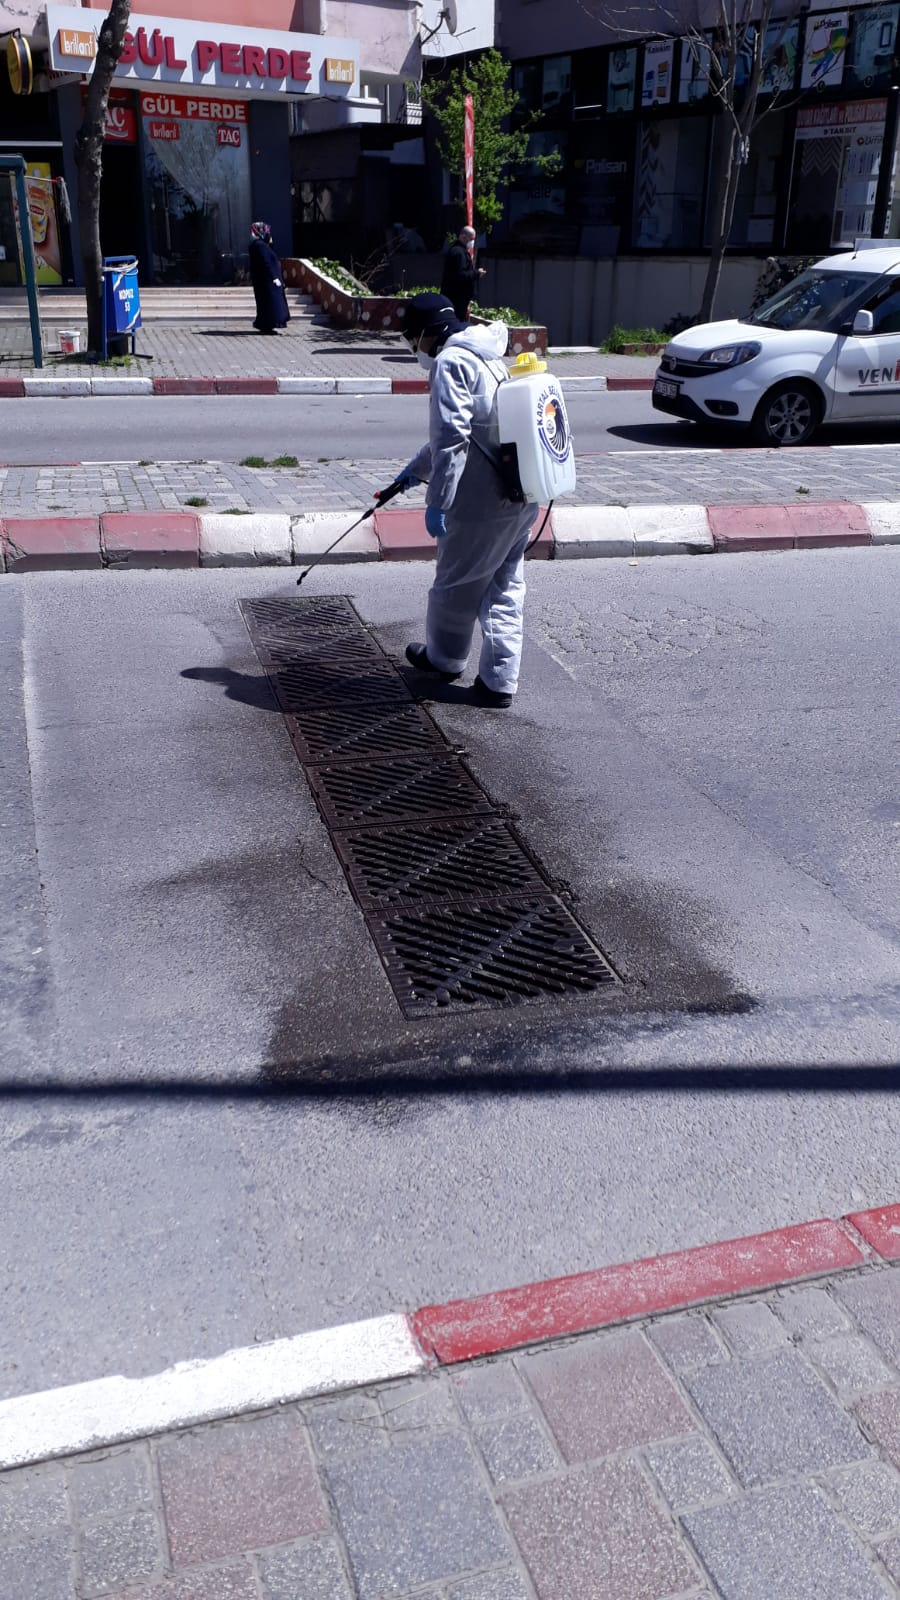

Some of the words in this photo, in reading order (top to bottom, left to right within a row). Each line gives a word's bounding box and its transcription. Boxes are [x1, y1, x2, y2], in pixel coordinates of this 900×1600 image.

[63, 31, 93, 57] brillant
[196, 40, 312, 81] PERDE
[104, 106, 126, 130] AÇ
[142, 95, 182, 115] GÜL
[186, 101, 246, 120] PERDE
[585, 158, 628, 175] Polisan
[536, 389, 549, 426] KARTAL
